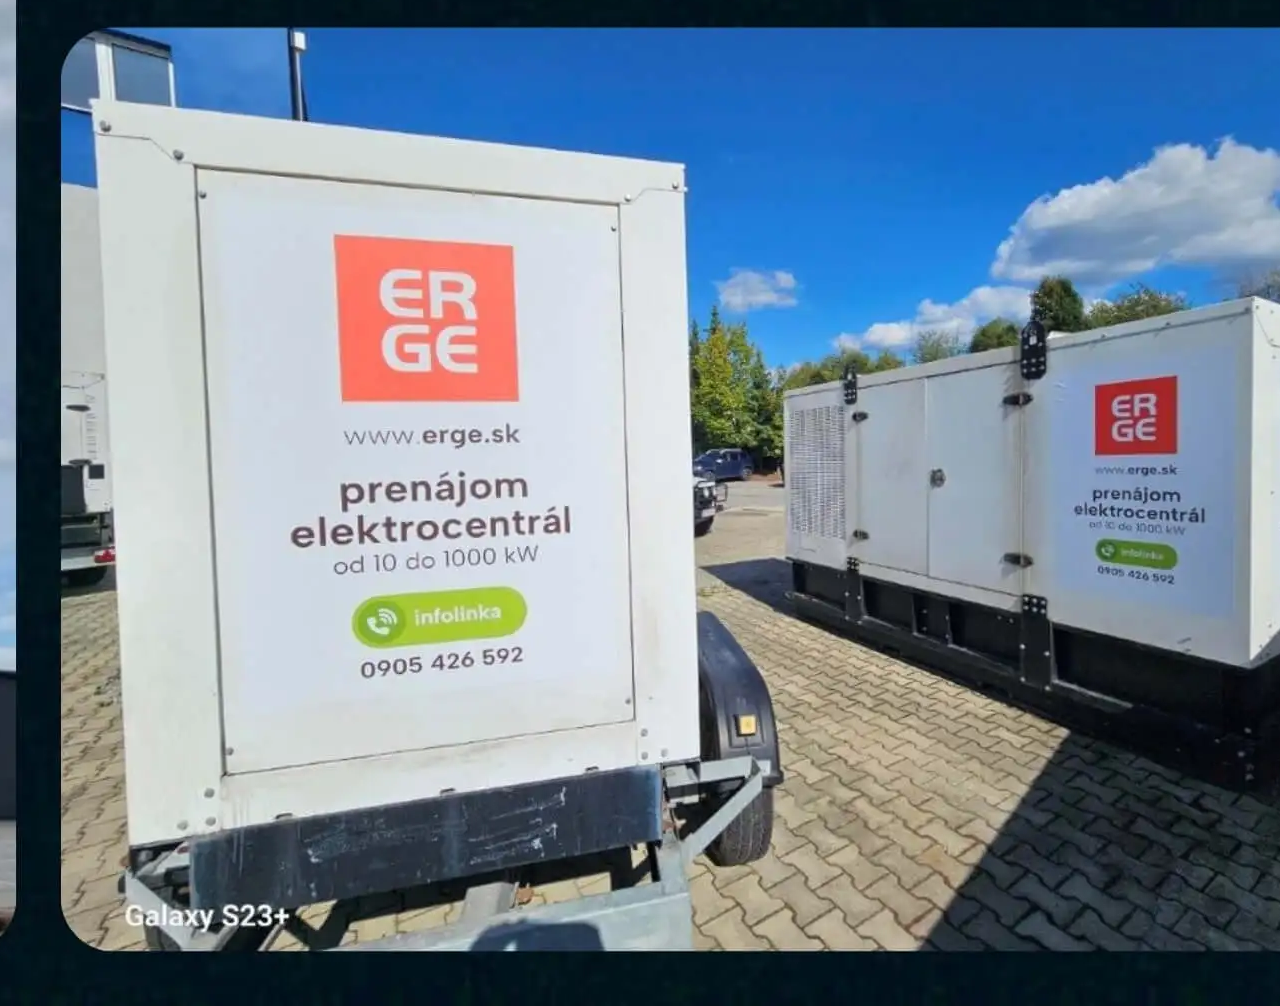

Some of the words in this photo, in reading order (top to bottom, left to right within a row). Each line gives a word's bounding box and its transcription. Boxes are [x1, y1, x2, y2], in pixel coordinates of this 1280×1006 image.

[379, 268, 478, 320] ER
[380, 324, 479, 374] GE
[1111, 393, 1157, 418] ER
[343, 423, 520, 449] www.erge.sk
[1111, 418, 1157, 442] GE
[1095, 464, 1178, 476] www.erge.sk
[339, 471, 529, 512] prenájom
[1092, 486, 1181, 504] prenájom
[1074, 502, 1206, 524] elektrocentrál
[290, 505, 571, 548] elektrocentrál
[1136, 522, 1163, 534] 1000
[1165, 524, 1186, 535] kW
[333, 555, 365, 575] od
[374, 553, 397, 572] 10
[405, 551, 436, 570] do
[443, 547, 497, 568] 1000
[504, 545, 539, 564] kW
[1097, 565, 1125, 577] 0905
[1127, 570, 1150, 582] 426
[1152, 573, 1175, 585] 592
[414, 604, 502, 626] infolinka
[360, 657, 423, 679] 0905
[430, 651, 475, 672] 426
[482, 646, 524, 666] 592
